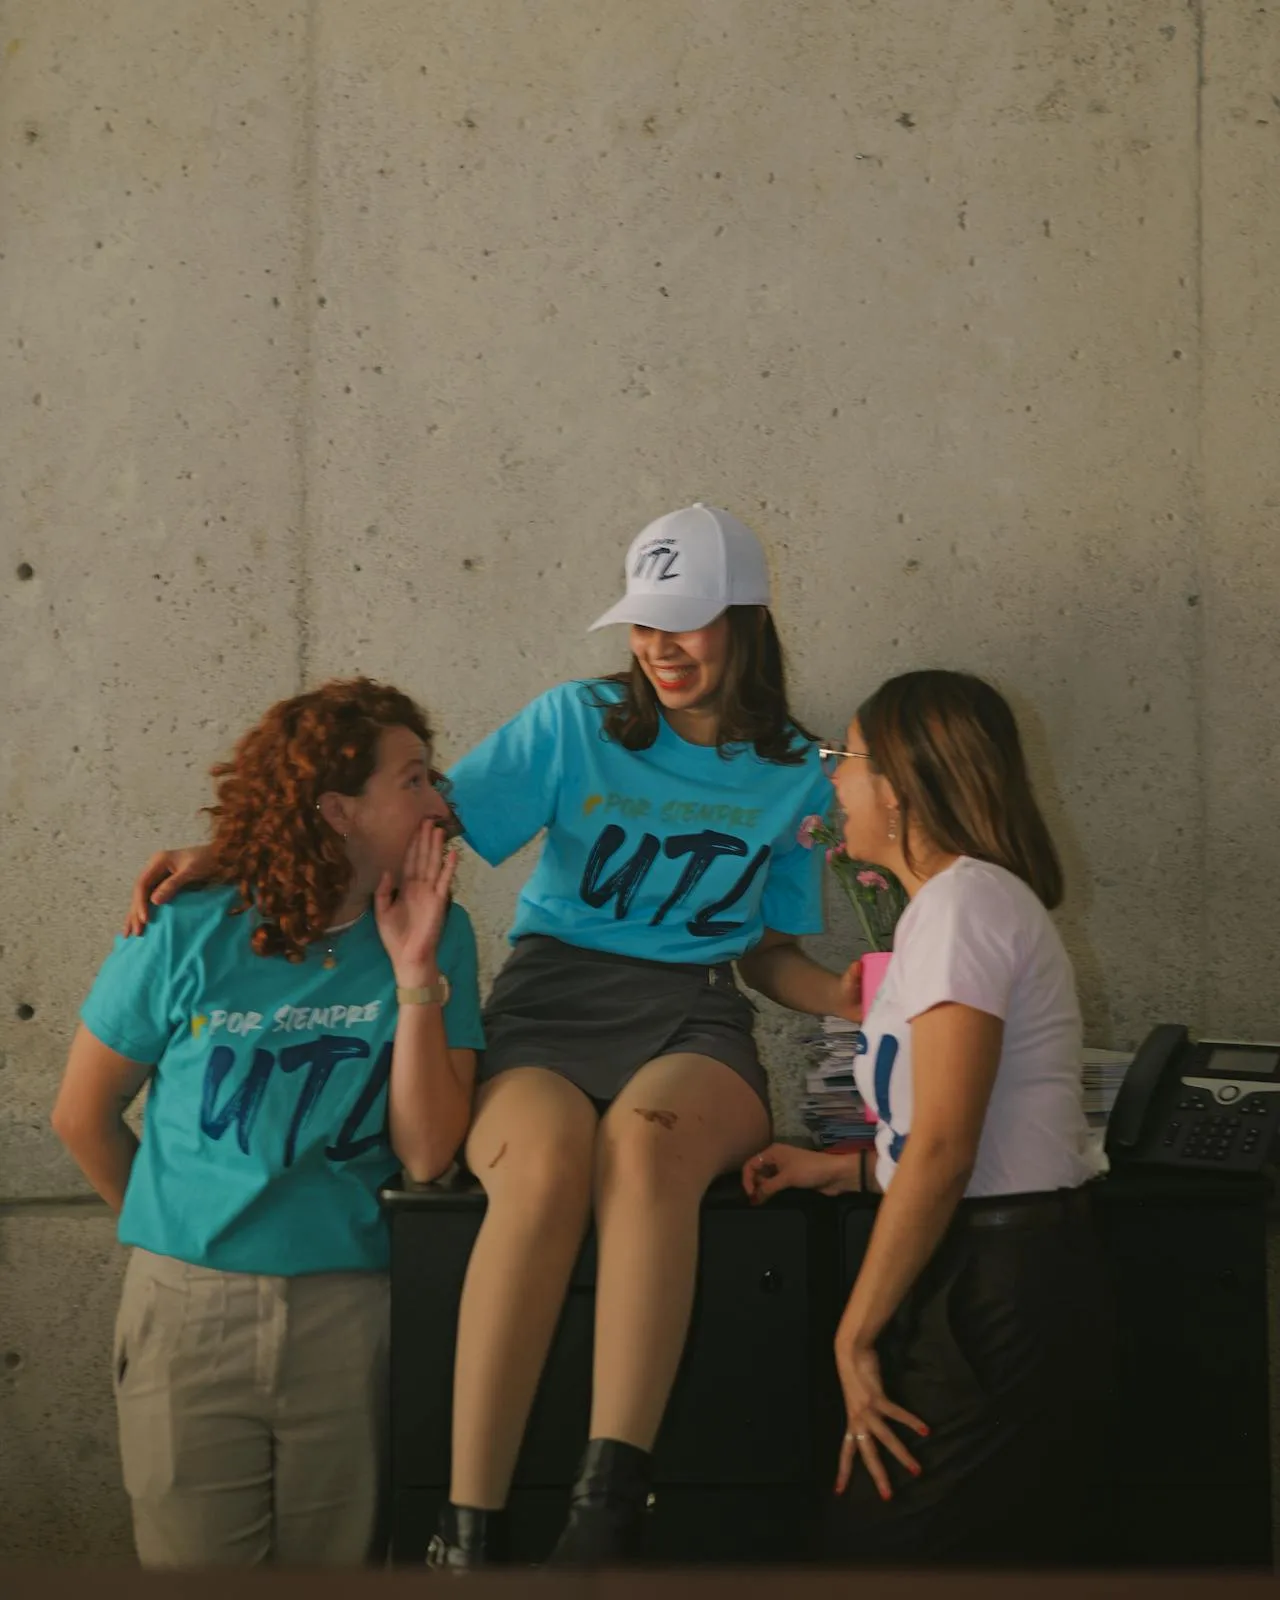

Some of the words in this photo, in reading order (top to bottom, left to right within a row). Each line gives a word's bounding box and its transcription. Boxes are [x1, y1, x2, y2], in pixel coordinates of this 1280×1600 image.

[603, 792, 651, 819] POR
[659, 799, 764, 828] SIEMPRE
[209, 1010, 264, 1037] POR
[272, 1000, 382, 1033] SIEMPRE
